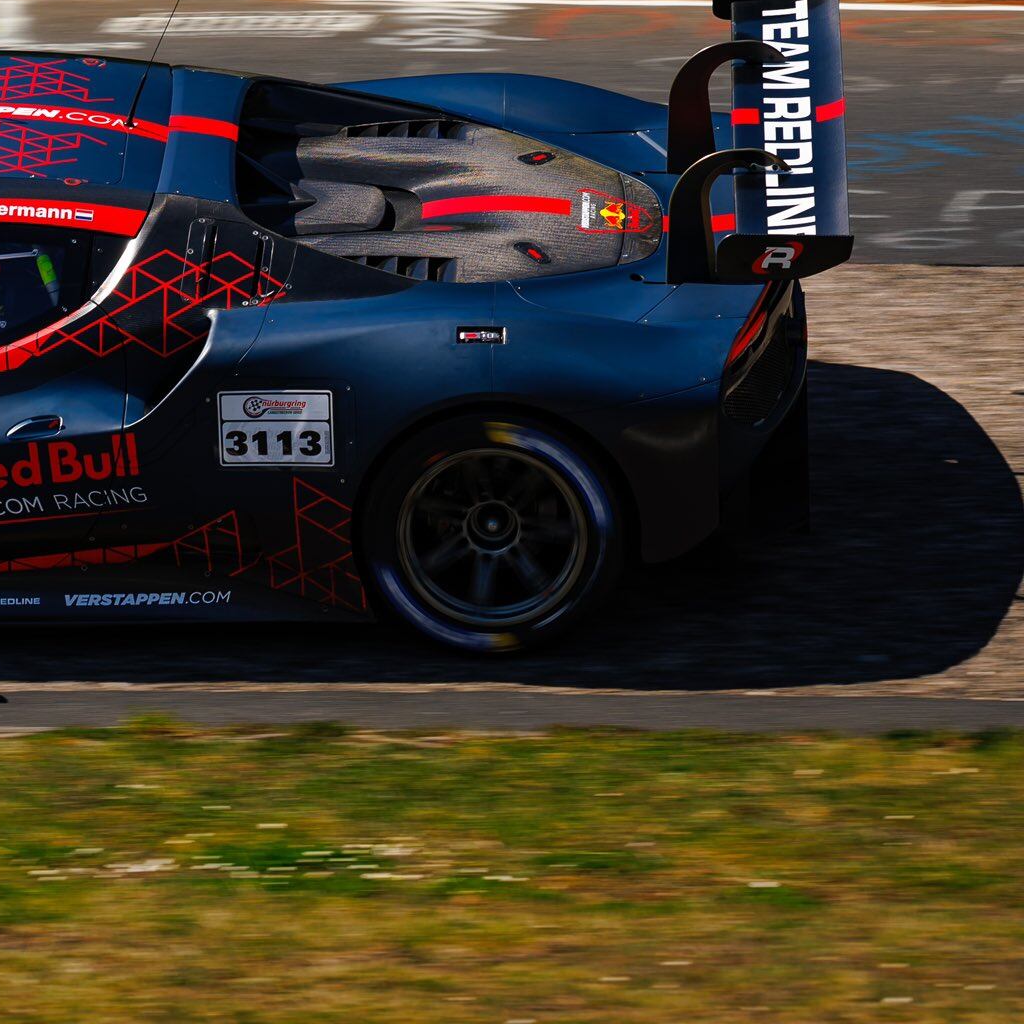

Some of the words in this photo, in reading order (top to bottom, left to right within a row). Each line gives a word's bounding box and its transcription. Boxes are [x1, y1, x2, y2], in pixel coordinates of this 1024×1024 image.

[762, 95, 817, 236] REDLIN
[225, 430, 322, 457] 3113
[47, 432, 141, 484] Bull
[52, 485, 149, 511] RACING
[63, 590, 232, 607] VERSTAPPEN.COM
